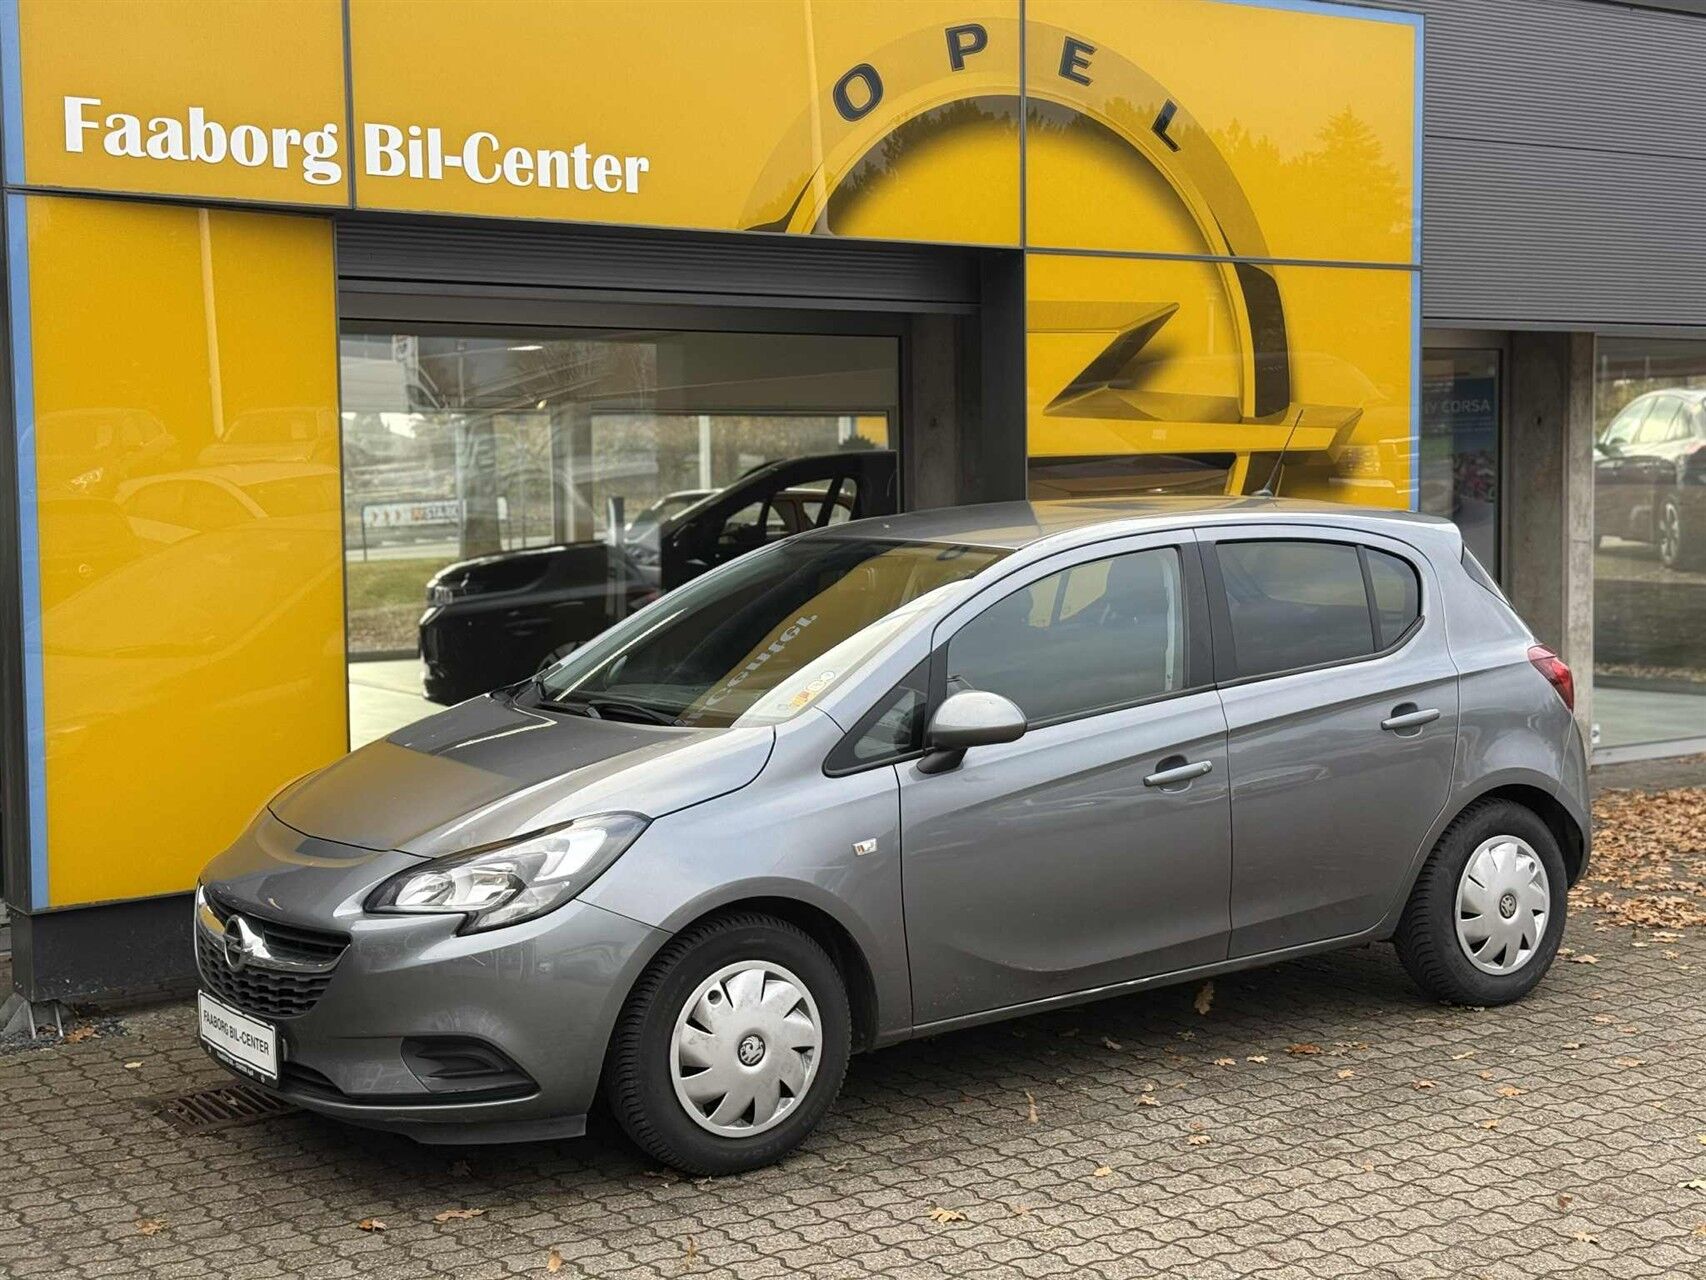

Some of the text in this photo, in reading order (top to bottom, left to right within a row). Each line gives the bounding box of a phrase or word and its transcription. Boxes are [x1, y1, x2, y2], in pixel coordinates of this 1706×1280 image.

[833, 23, 1181, 152] OPEL
[64, 96, 650, 193] Faaborg Bil-Center
[1441, 399, 1491, 413] CORSA
[203, 1009, 269, 1055] FAABORG BIL-CENTER
